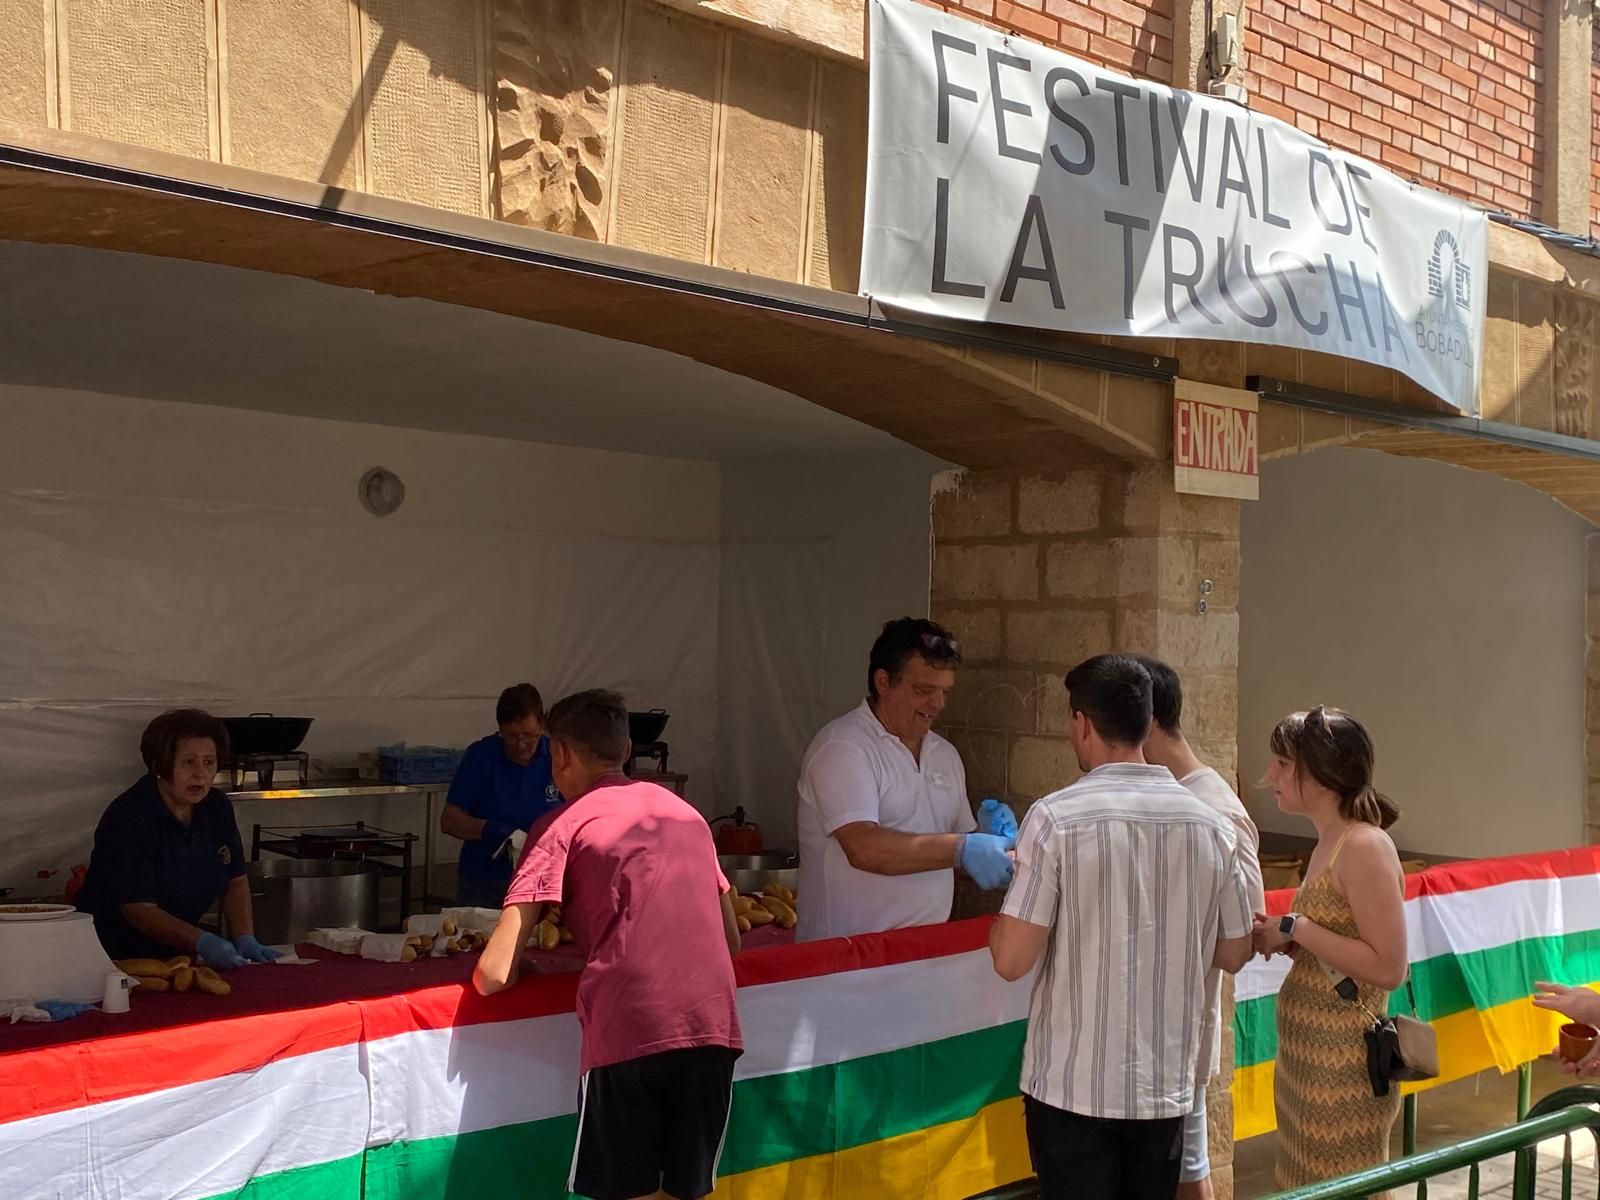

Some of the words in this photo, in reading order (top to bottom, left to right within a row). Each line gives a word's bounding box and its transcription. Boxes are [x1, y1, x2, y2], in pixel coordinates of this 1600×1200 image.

[931, 30, 1291, 231] FESTIVAL
[1308, 149, 1380, 256] DE
[931, 178, 1067, 311] LA
[1105, 210, 1409, 362] TRUCHA
[1177, 401, 1259, 474] ENTRADA
